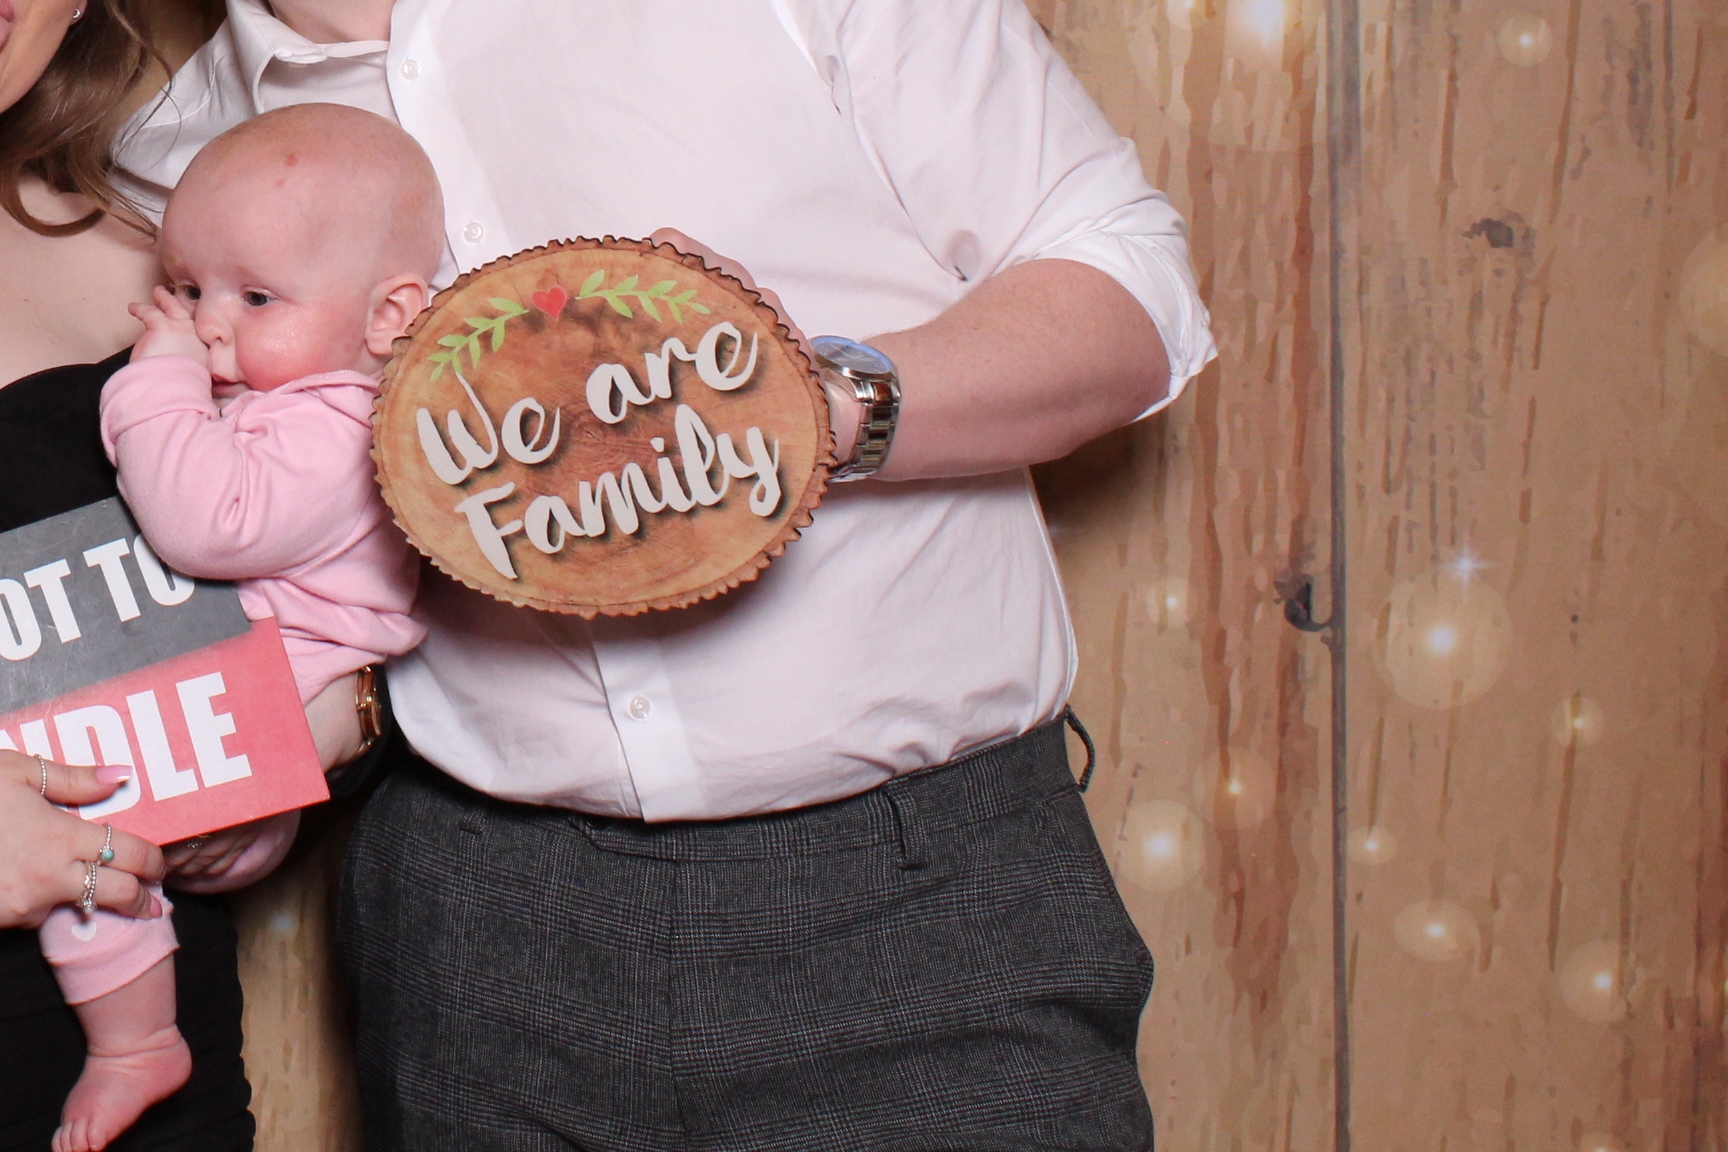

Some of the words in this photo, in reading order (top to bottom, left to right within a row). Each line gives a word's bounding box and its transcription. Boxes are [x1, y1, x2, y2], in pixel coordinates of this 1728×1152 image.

[415, 371, 560, 485] We
[585, 321, 759, 424] are
[453, 403, 780, 580] Family
[82, 533, 196, 623] TO
